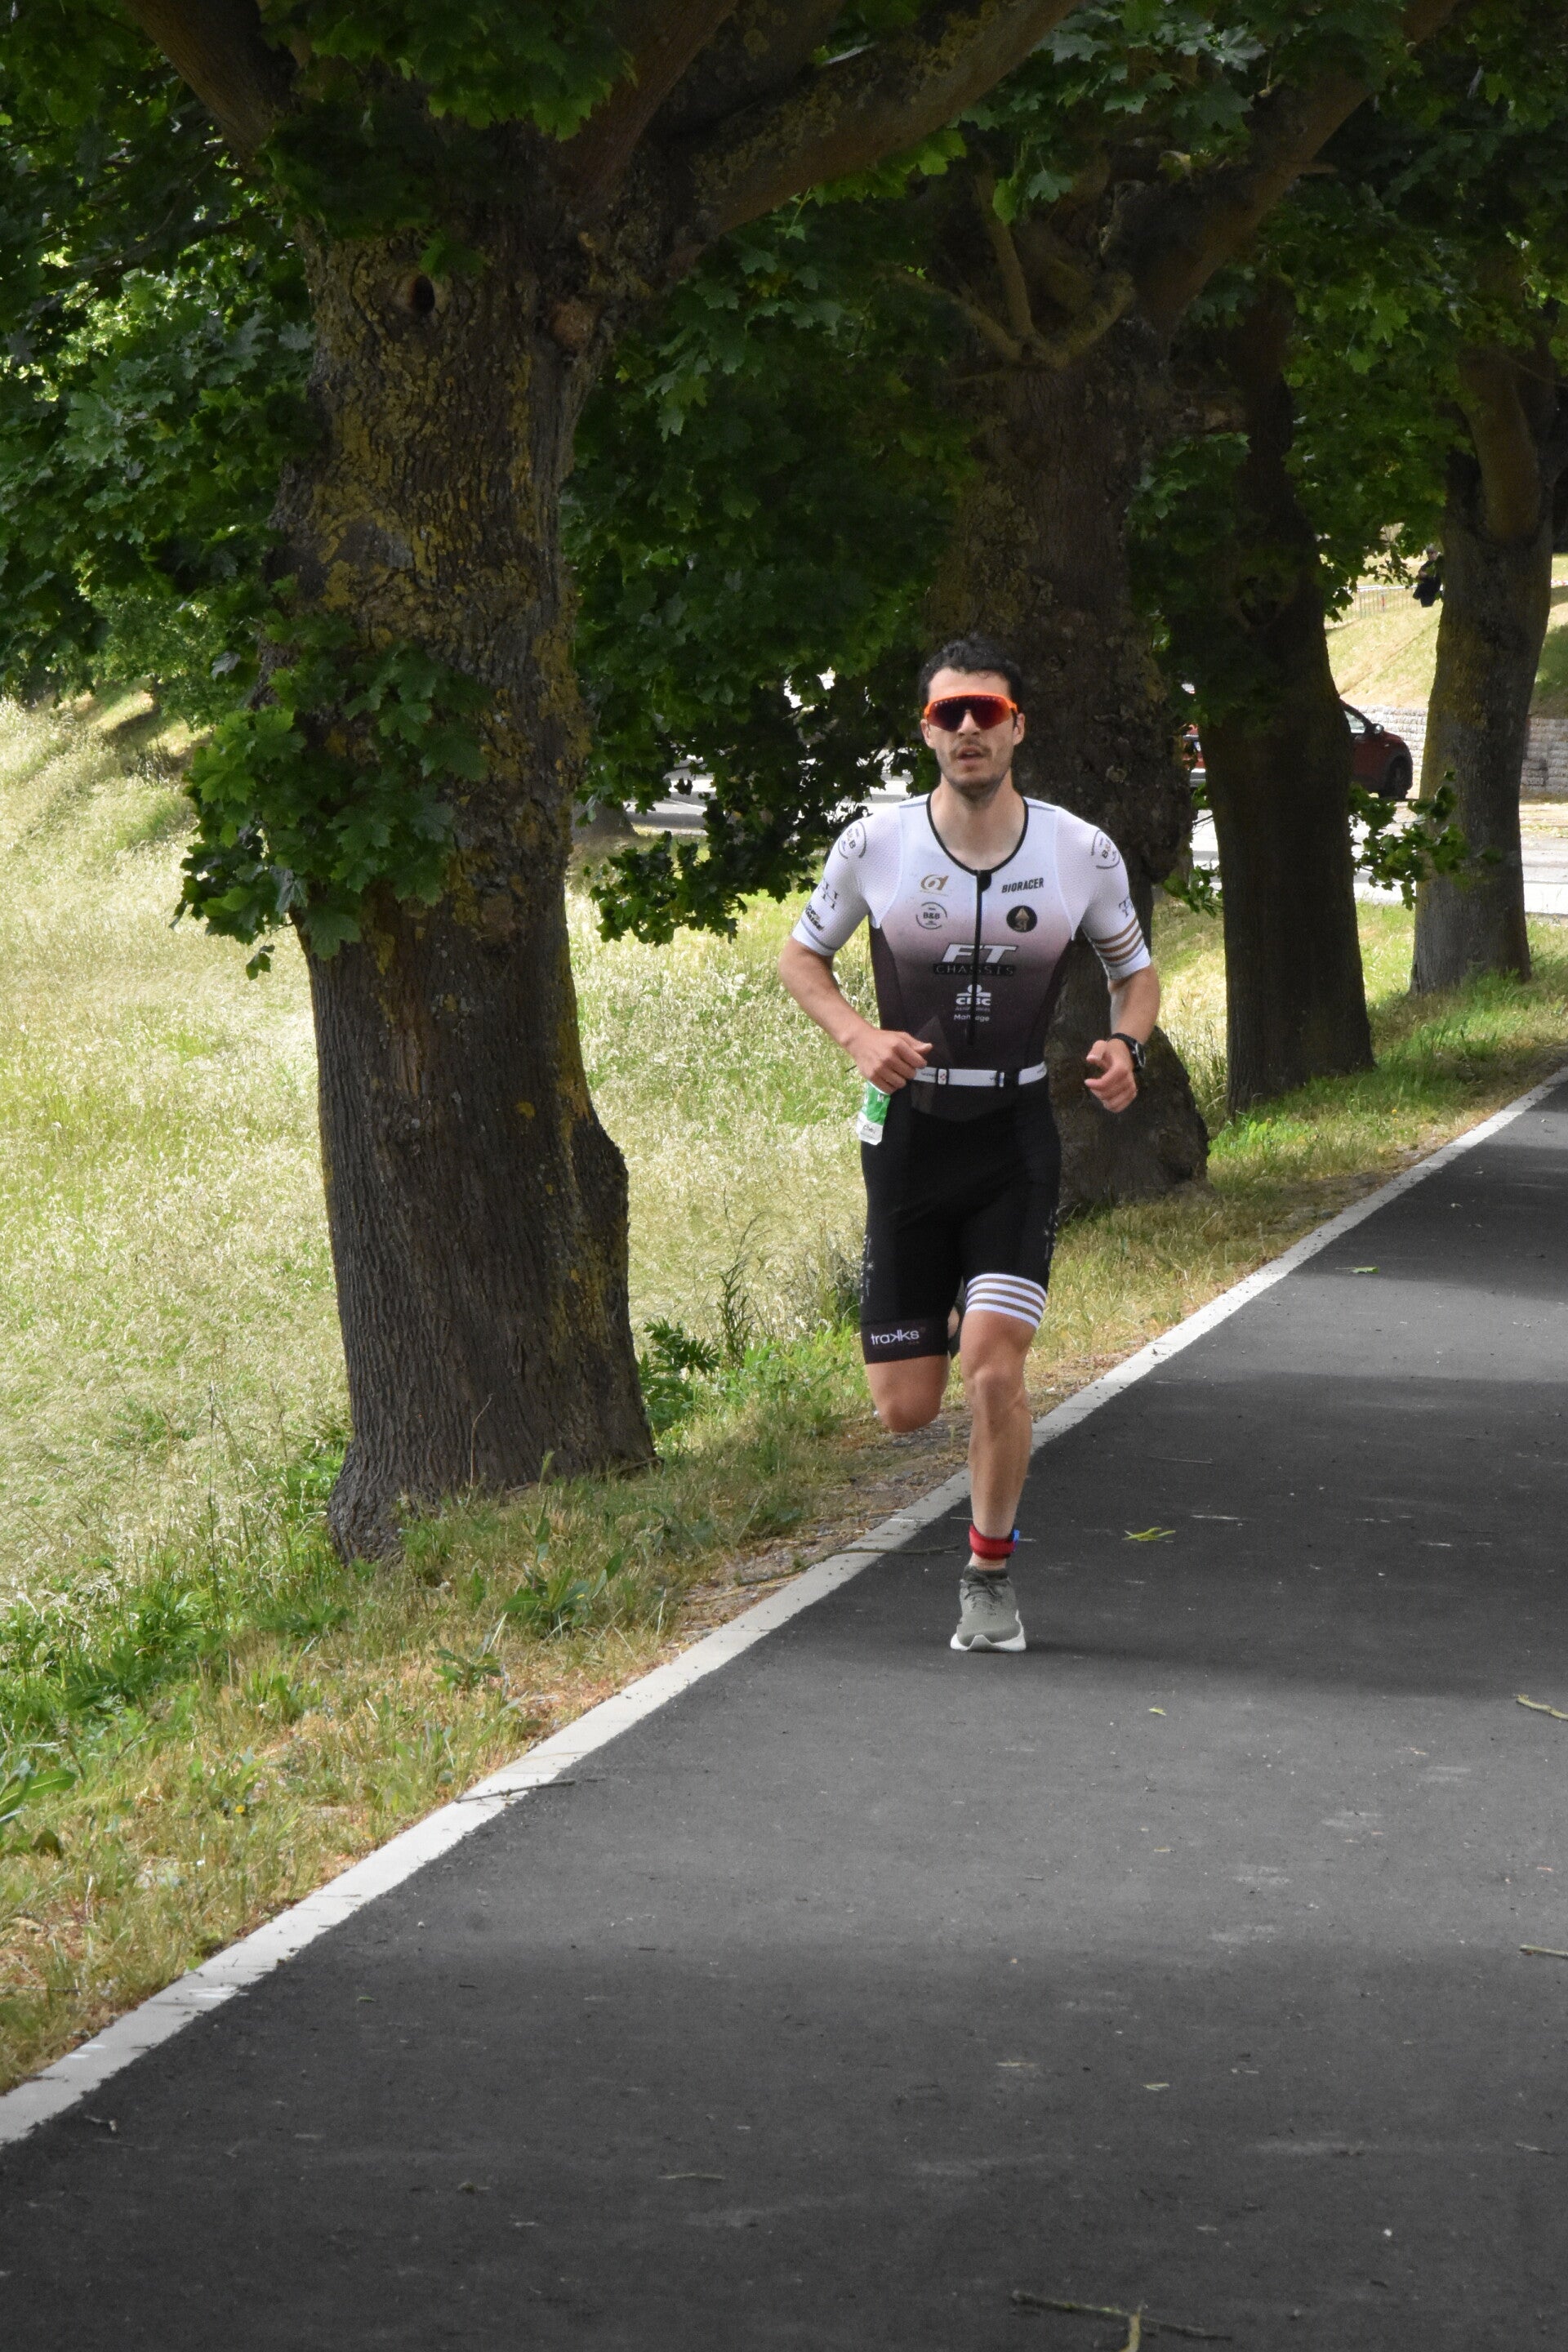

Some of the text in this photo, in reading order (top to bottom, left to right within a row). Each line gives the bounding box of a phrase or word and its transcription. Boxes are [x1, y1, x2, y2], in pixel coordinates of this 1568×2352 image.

[1001, 877, 1045, 893] BIORACER
[923, 911, 940, 920] B&B
[941, 943, 1018, 964] FT
